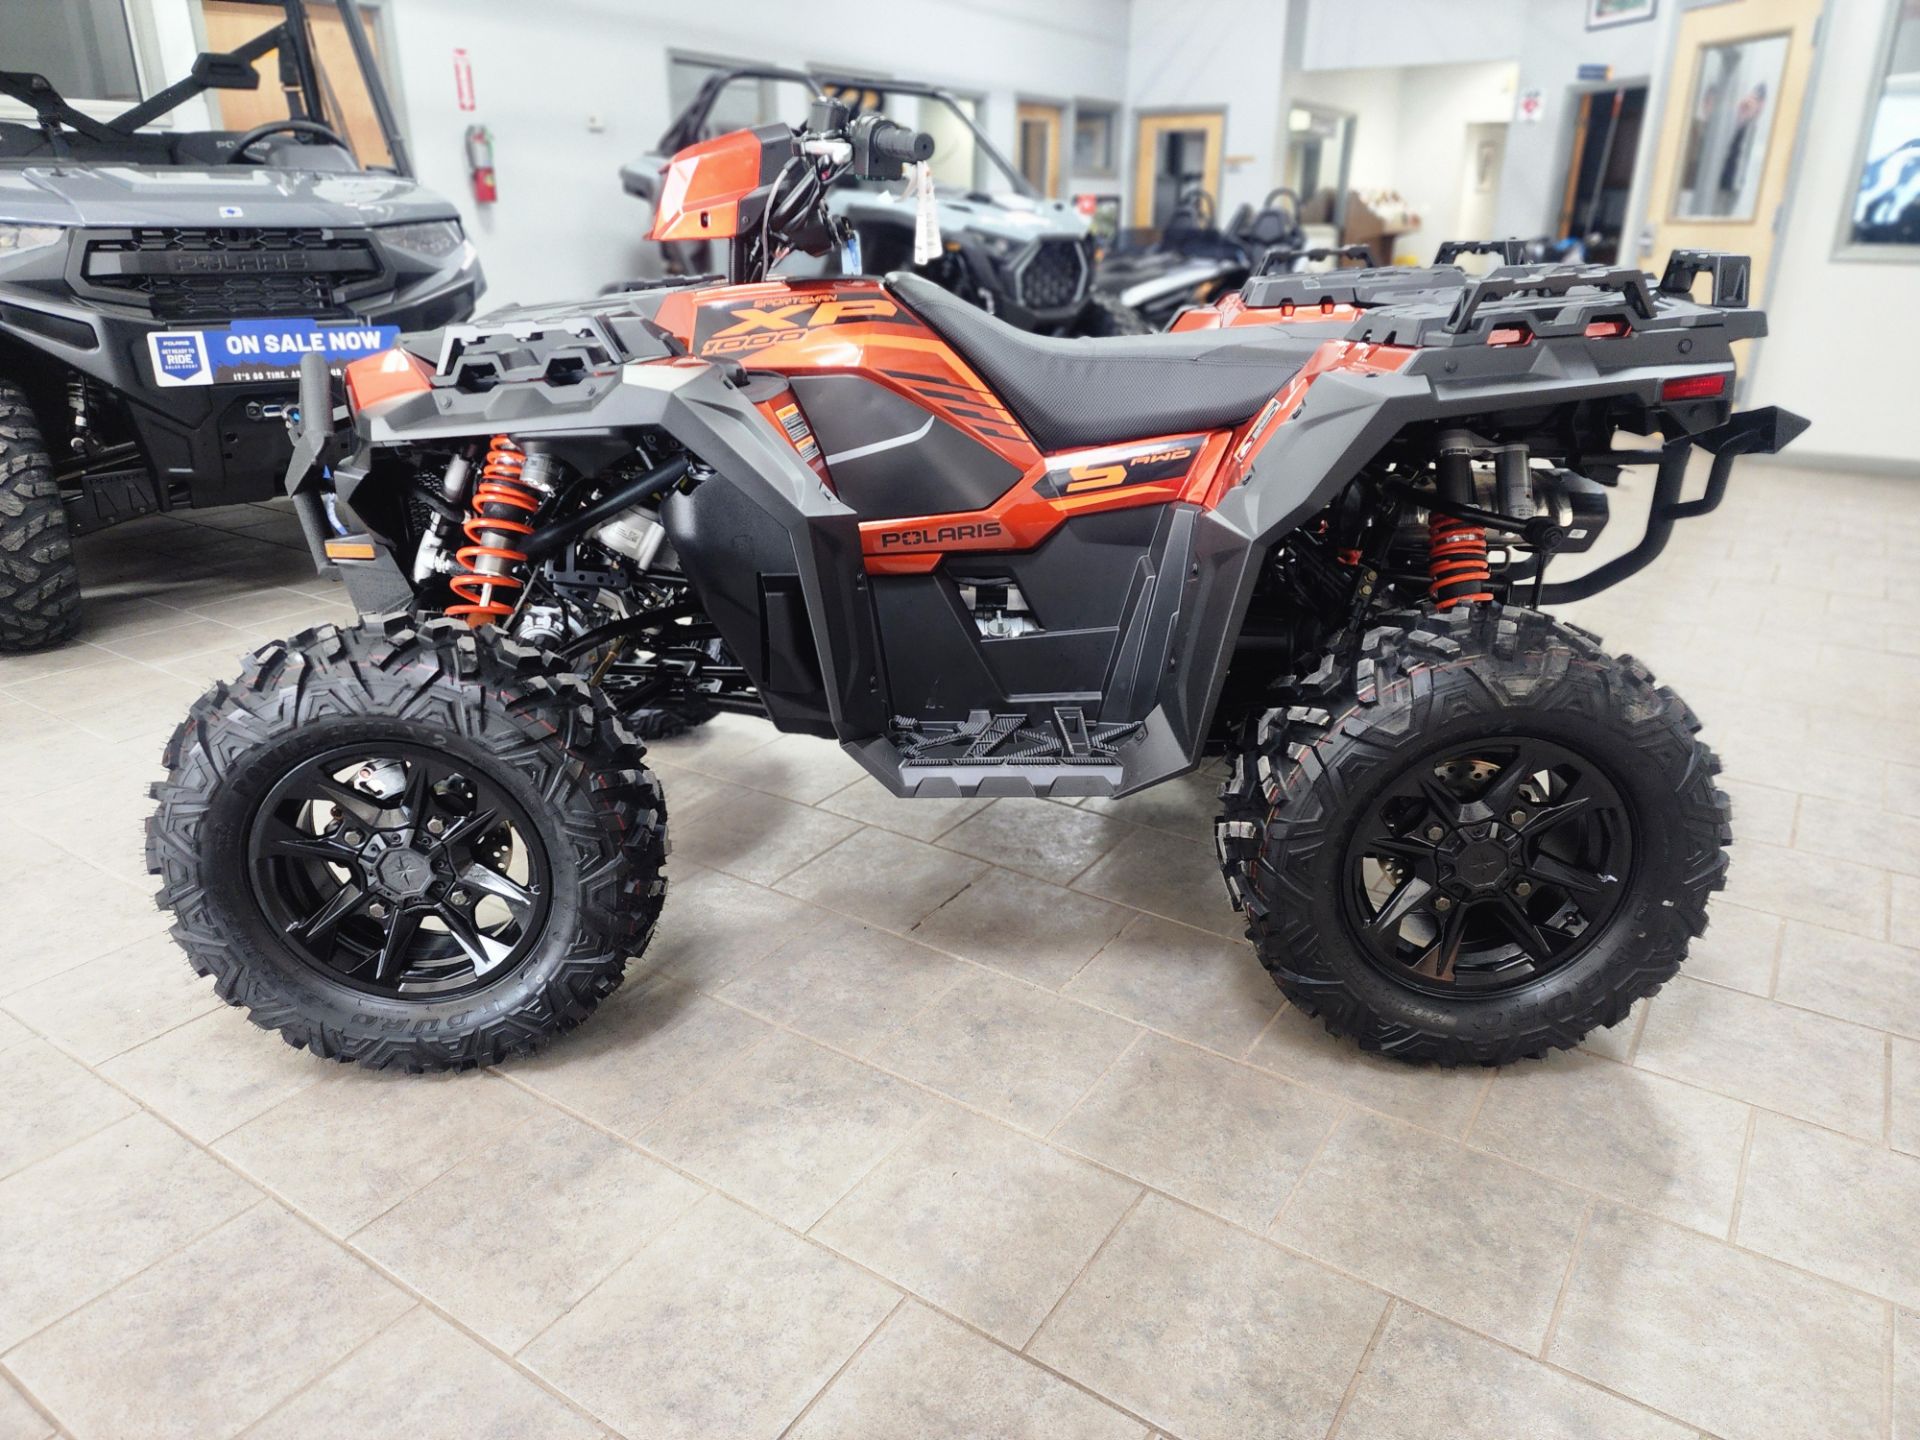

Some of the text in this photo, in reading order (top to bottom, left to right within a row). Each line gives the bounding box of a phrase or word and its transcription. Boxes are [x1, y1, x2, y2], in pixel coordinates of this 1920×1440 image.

[178, 253, 308, 271] POLARIS
[754, 294, 838, 308] SPORTSMAN
[712, 300, 898, 337] XP
[226, 331, 382, 355] ON SALE NOW
[701, 328, 809, 355] 1000
[166, 353, 194, 365] RIDE
[1130, 449, 1192, 466] AWD
[1066, 464, 1128, 492] S
[881, 522, 1002, 548] POLARIS
[351, 1010, 473, 1036] DURO
